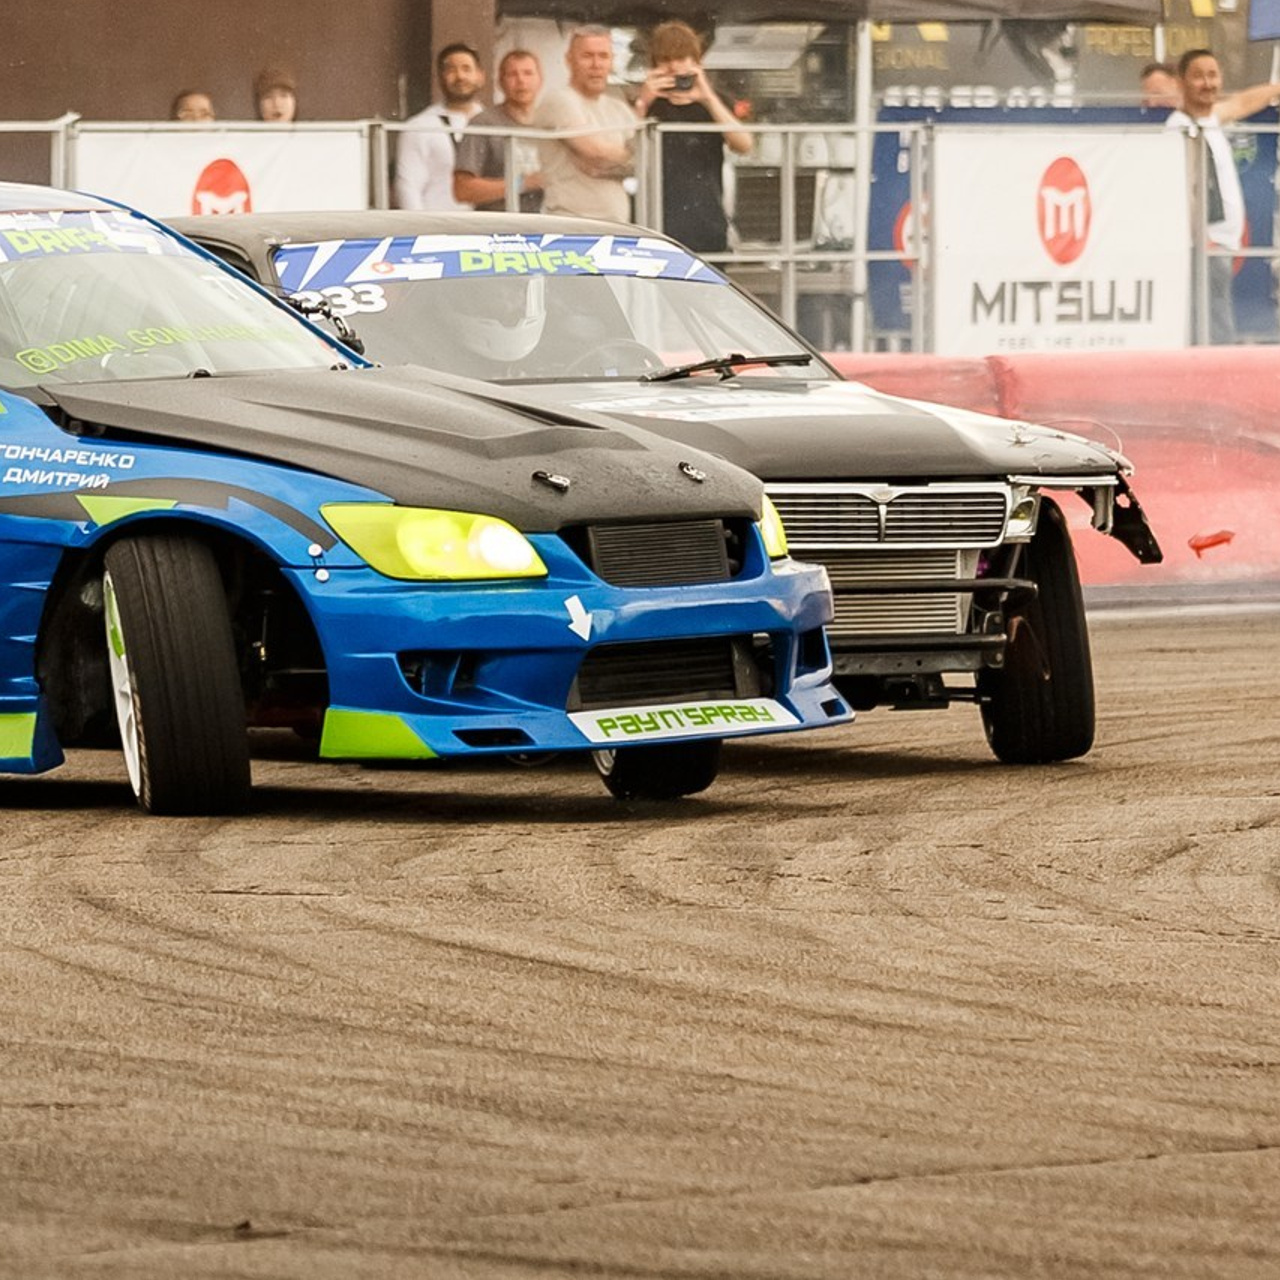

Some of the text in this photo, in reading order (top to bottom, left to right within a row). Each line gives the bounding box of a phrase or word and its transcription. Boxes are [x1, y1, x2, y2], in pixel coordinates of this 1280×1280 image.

[459, 249, 599, 274] DRIFT
[971, 280, 1154, 324] MITSUJI
[2, 467, 111, 489] ДМИТРИЙ
